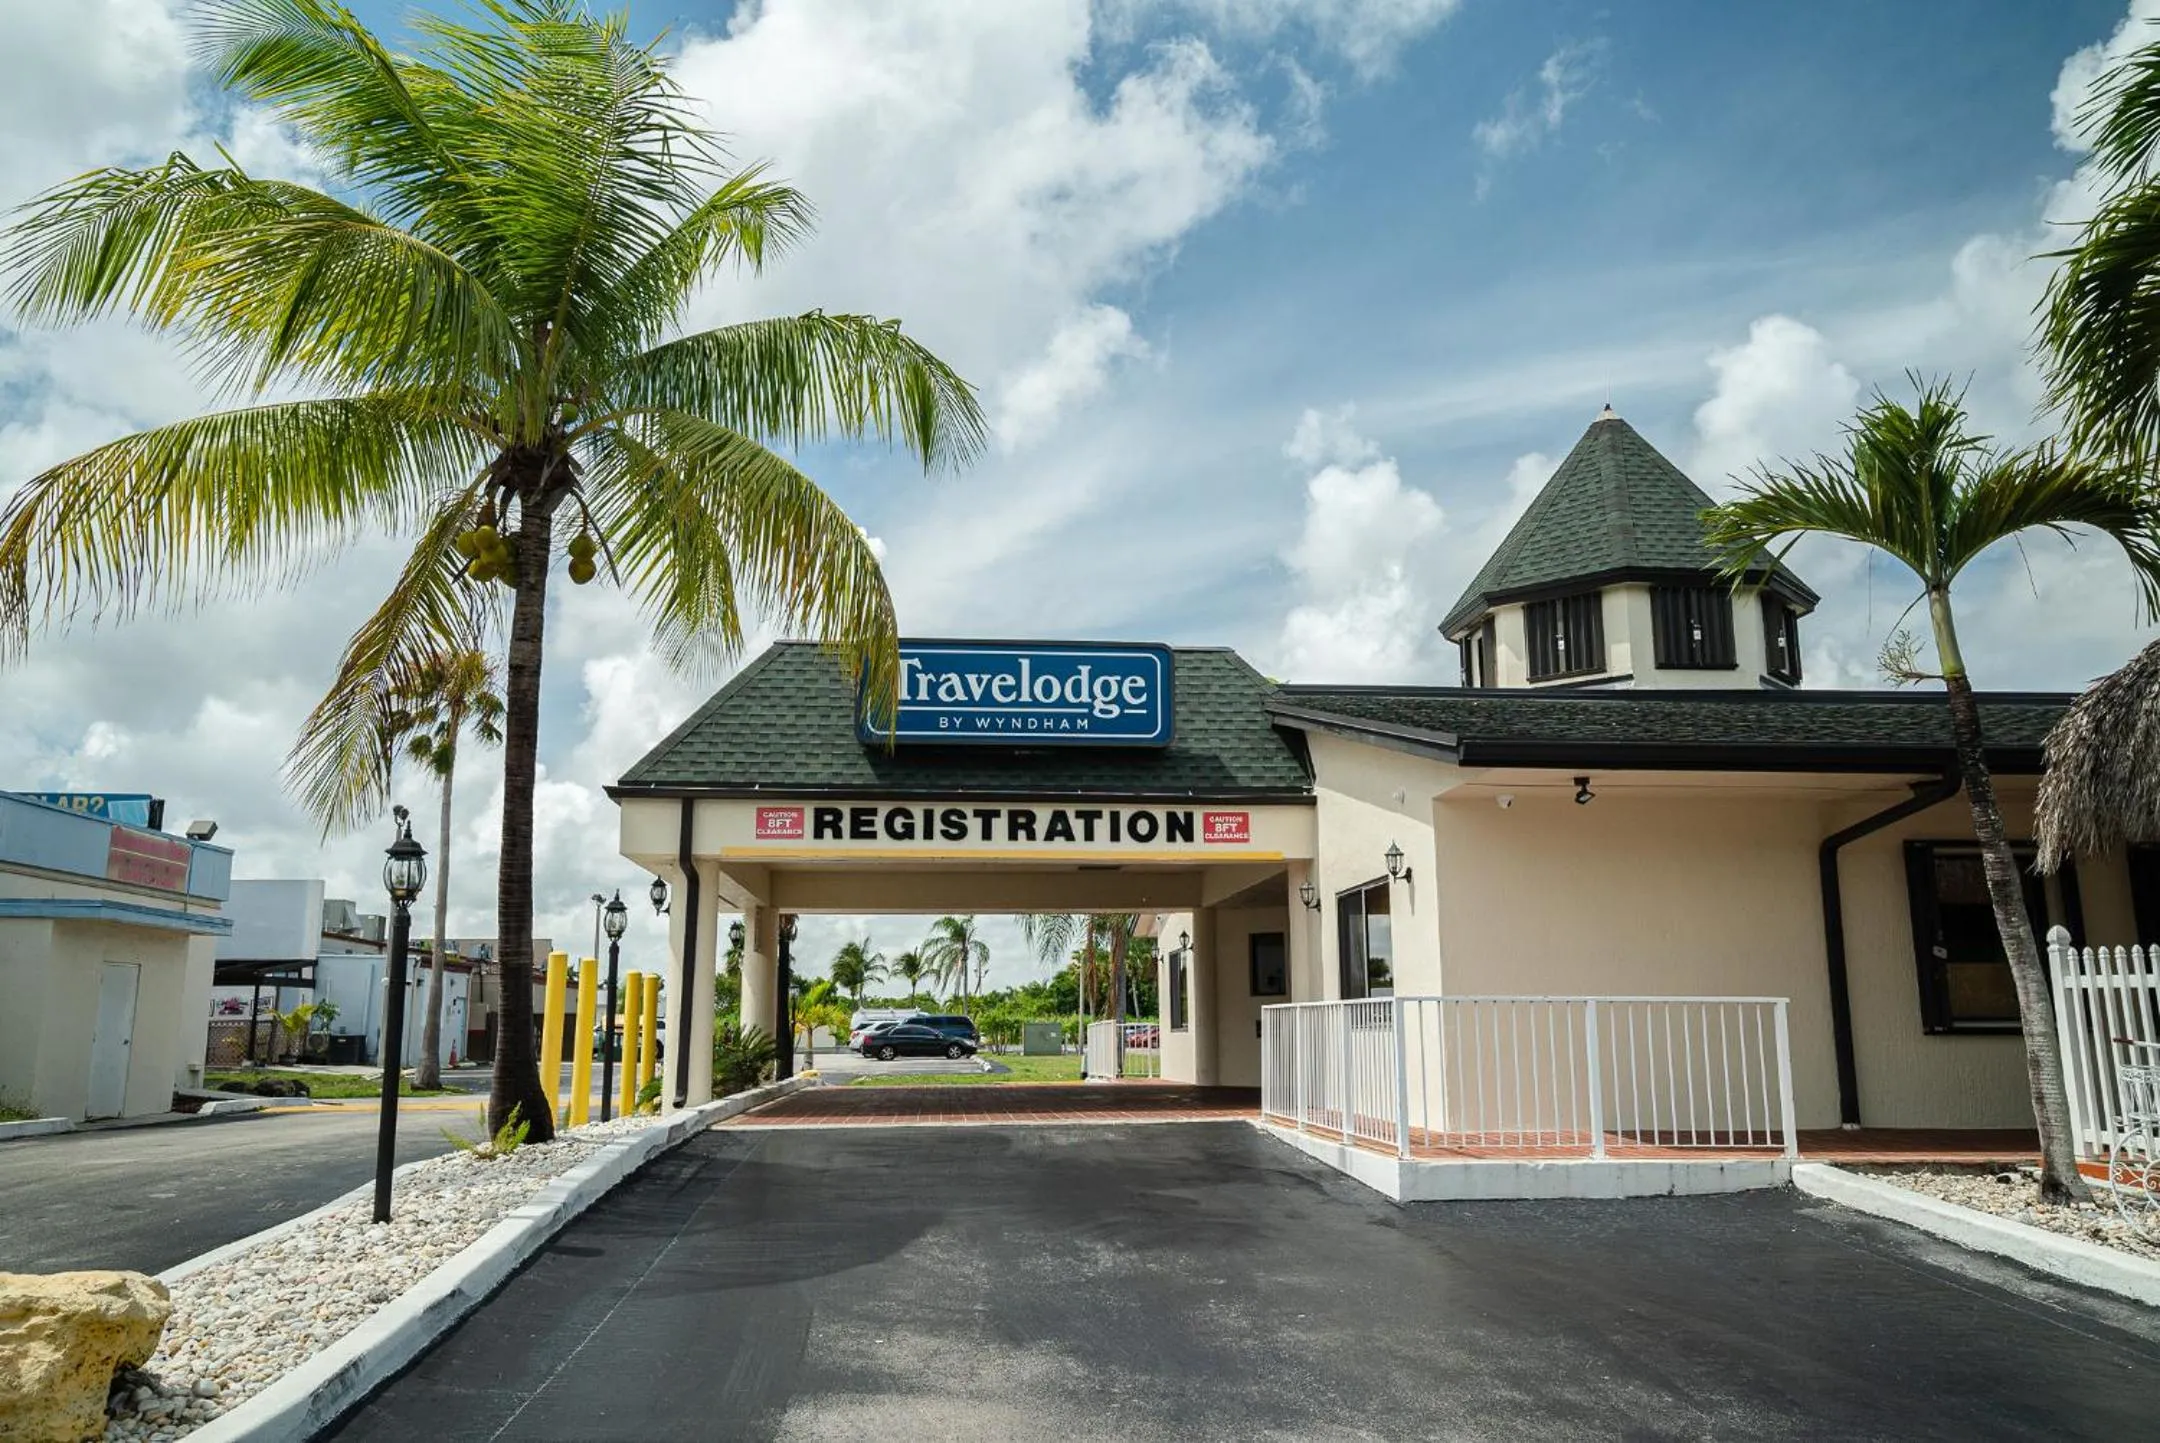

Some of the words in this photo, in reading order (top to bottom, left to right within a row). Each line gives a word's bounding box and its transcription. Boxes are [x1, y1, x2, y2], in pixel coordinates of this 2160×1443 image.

[898, 657, 1147, 719] Travelodge
[939, 716, 961, 729] BY
[975, 717, 1089, 730] WYNDHAM
[768, 819, 792, 828] 8FT
[813, 807, 1194, 843] REGISTRATION
[1215, 823, 1237, 832] 8FT
